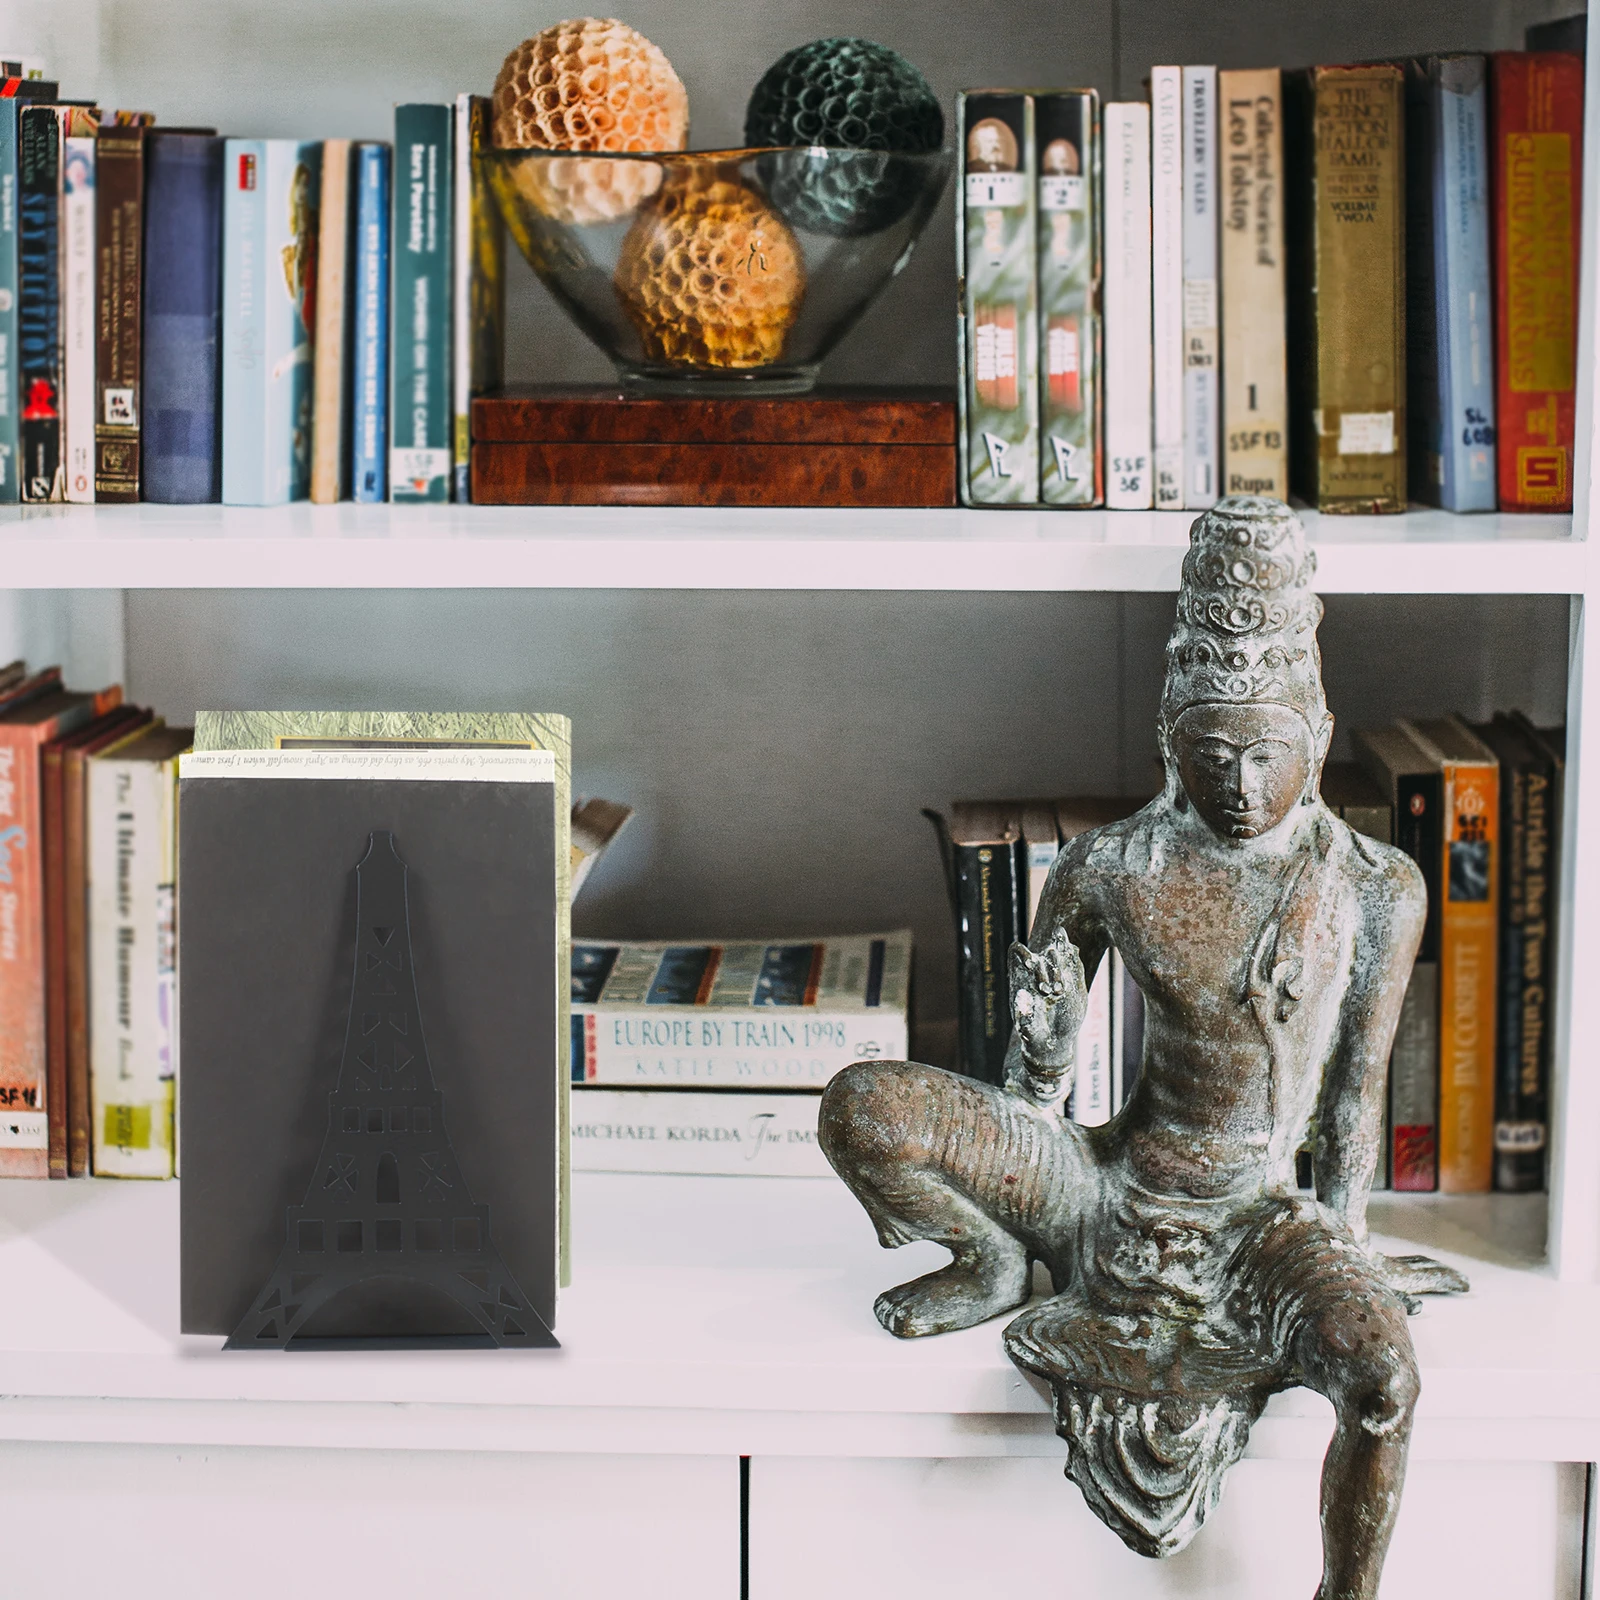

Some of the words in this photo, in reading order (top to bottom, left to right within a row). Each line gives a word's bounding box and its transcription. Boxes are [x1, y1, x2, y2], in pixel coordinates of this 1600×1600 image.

[1336, 88, 1371, 103] THE
[1160, 77, 1175, 175] CARABOO
[1229, 99, 1253, 147] Leo
[1319, 104, 1387, 118] SCIENC
[1256, 96, 1274, 180] Collected
[411, 145, 424, 178] Sara
[1193, 171, 1207, 214] TALES
[1225, 153, 1253, 233] Tolstoy
[1510, 134, 1537, 222] GURU
[408, 183, 424, 252] Paretsky
[1256, 184, 1275, 246] Stories
[1330, 202, 1377, 212] VOLUME
[1335, 213, 1363, 223] TWO
[1256, 248, 1276, 269] of
[1510, 226, 1537, 318] AMAR
[239, 239, 253, 318] MANSELL
[414, 276, 428, 341] WOMEN
[1543, 291, 1568, 340] SRI
[414, 344, 428, 369] ON
[414, 373, 428, 404] THE
[1247, 383, 1257, 411] 1
[1113, 456, 1146, 472] SSF
[1120, 476, 1140, 492] 36
[1230, 474, 1274, 495] Rupa
[217, 754, 236, 768] first
[243, 757, 266, 767] when
[267, 754, 304, 768] snowfall
[305, 755, 328, 767] April
[341, 755, 368, 767] during
[369, 757, 384, 767] did
[384, 755, 402, 767] they
[433, 755, 459, 767] spirits
[460, 755, 476, 767] My
[529, 757, 542, 768] the
[117, 773, 132, 804] The
[1527, 772, 1548, 869] Astride
[1525, 876, 1547, 917] the
[1524, 920, 1547, 979] Two
[117, 926, 136, 1030] Humour
[1453, 941, 1481, 1048] CORBETT
[614, 1019, 694, 1047] EUROPE
[701, 1020, 725, 1047] BY
[731, 1020, 796, 1048] TRAIN
[803, 1021, 847, 1048] 1998
[1522, 984, 1545, 1095] Cultures
[635, 1058, 713, 1077] KATIE
[736, 1059, 826, 1078] WOOD
[571, 1122, 659, 1141] MICHAEL
[666, 1125, 742, 1143] KORDA
[744, 1113, 781, 1161] The
